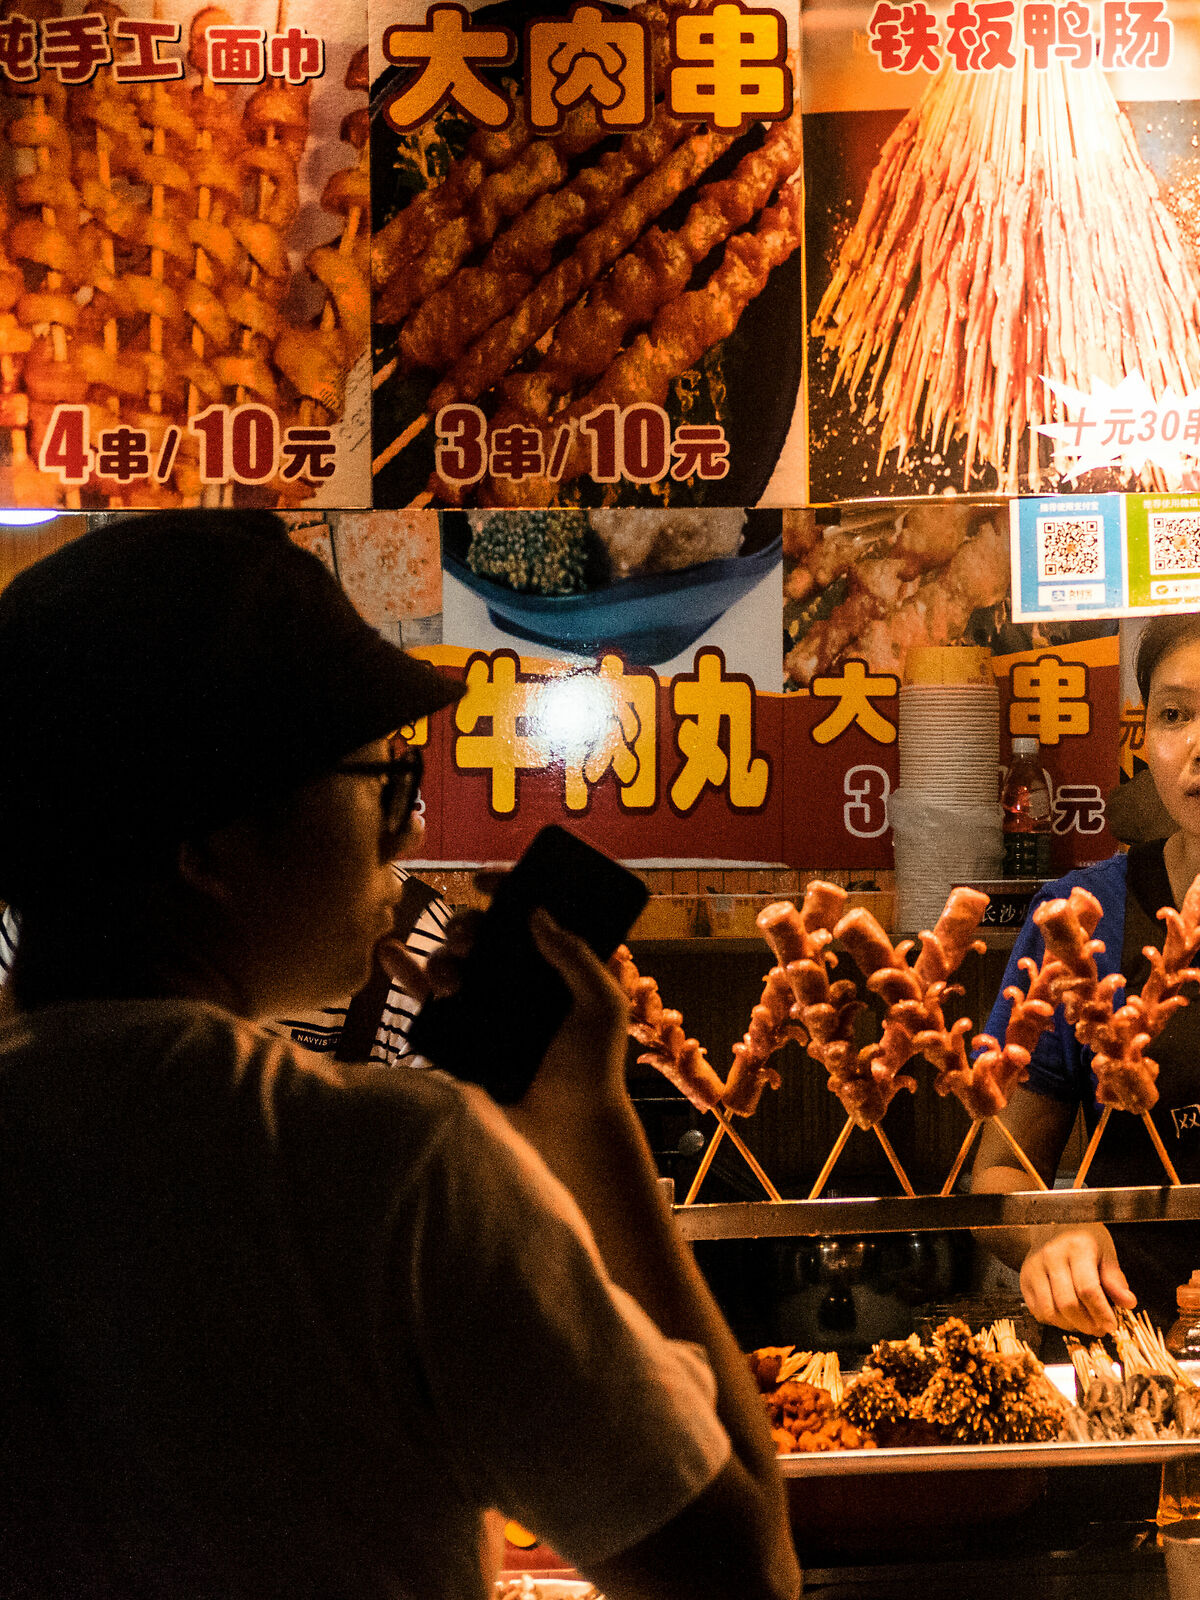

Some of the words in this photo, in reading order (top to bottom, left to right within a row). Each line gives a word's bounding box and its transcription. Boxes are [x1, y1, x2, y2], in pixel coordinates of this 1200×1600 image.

[205, 25, 324, 84] 面巾
[383, 0, 796, 135] 大肉串
[868, 0, 1175, 73] 铁板鸭肠
[39, 402, 336, 485] 4串/10元
[434, 403, 731, 486] 3串/10元
[452, 646, 770, 814] 牛肉丸
[811, 655, 1091, 748] 大串
[981, 904, 1027, 924] 长沙
